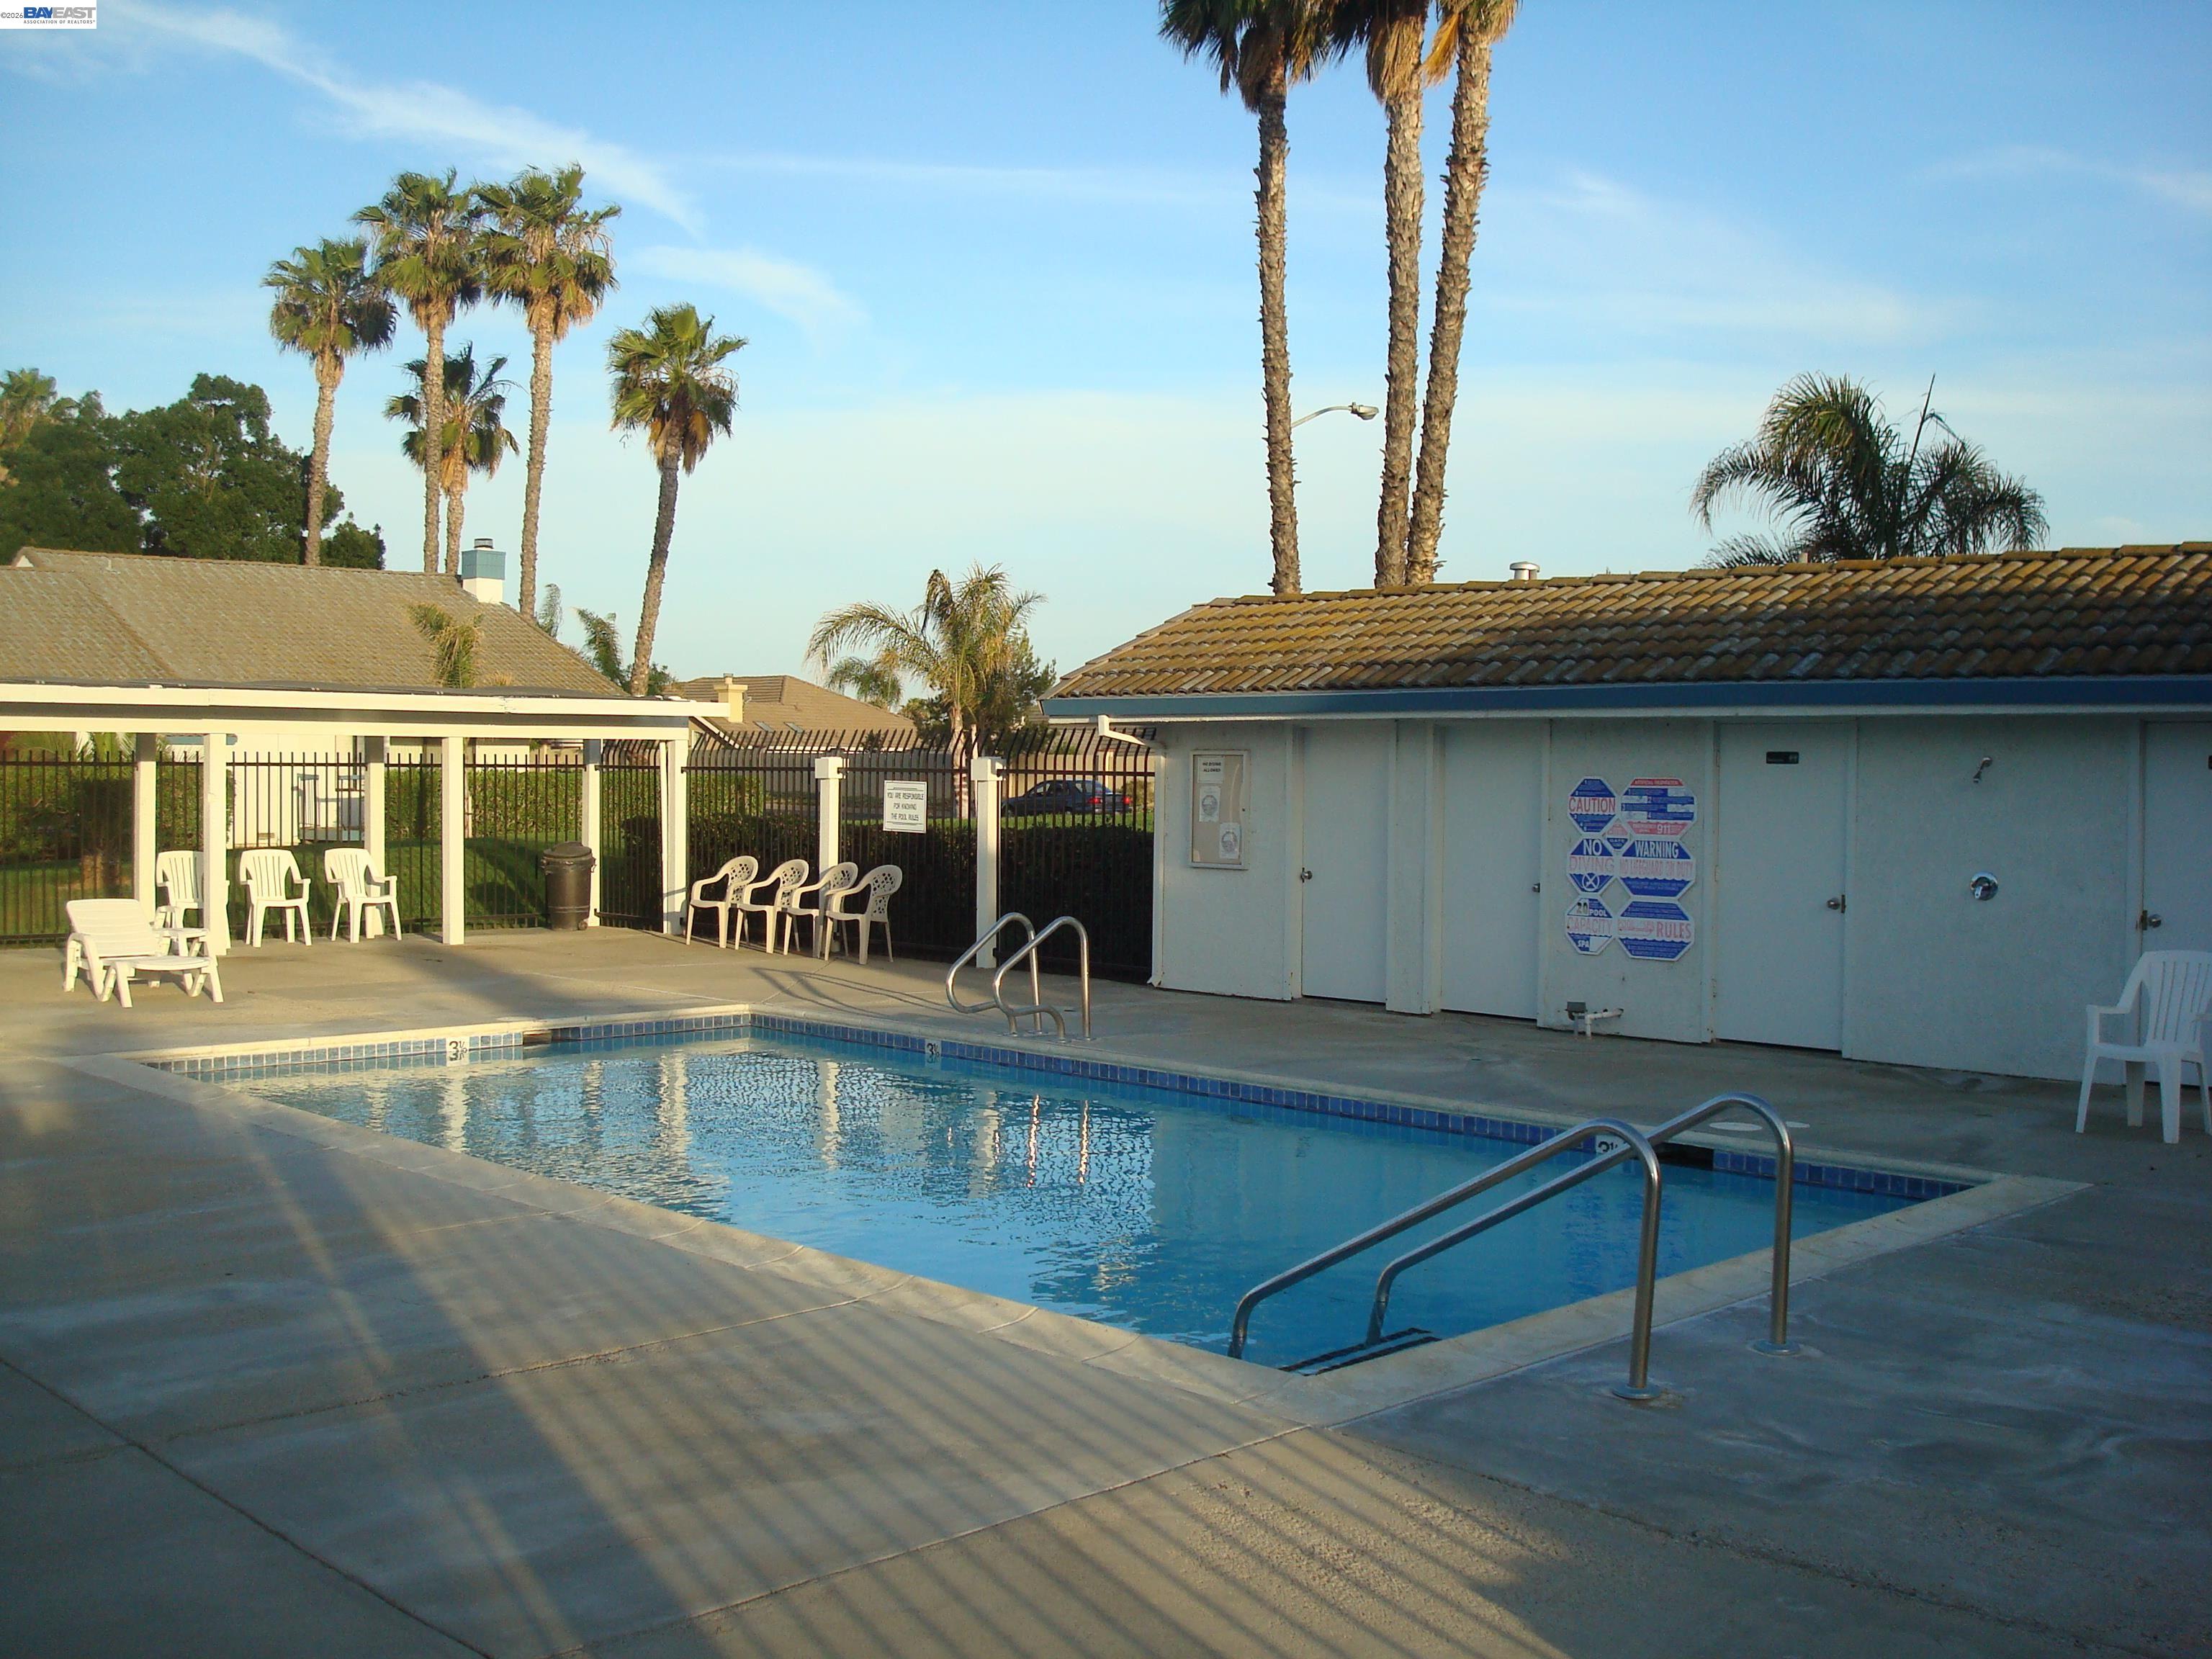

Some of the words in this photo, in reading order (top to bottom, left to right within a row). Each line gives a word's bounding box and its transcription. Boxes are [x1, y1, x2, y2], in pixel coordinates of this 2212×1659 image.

[1568, 797, 1616, 813] CAUTION
[1657, 824, 1671, 834] 911
[1583, 839, 1602, 856] NO
[1635, 840, 1679, 859] WARNING
[1569, 856, 1614, 873] DIVING
[1577, 902, 1588, 914] 20
[1567, 917, 1613, 934] CAPACITY
[1657, 921, 1691, 939] RULES
